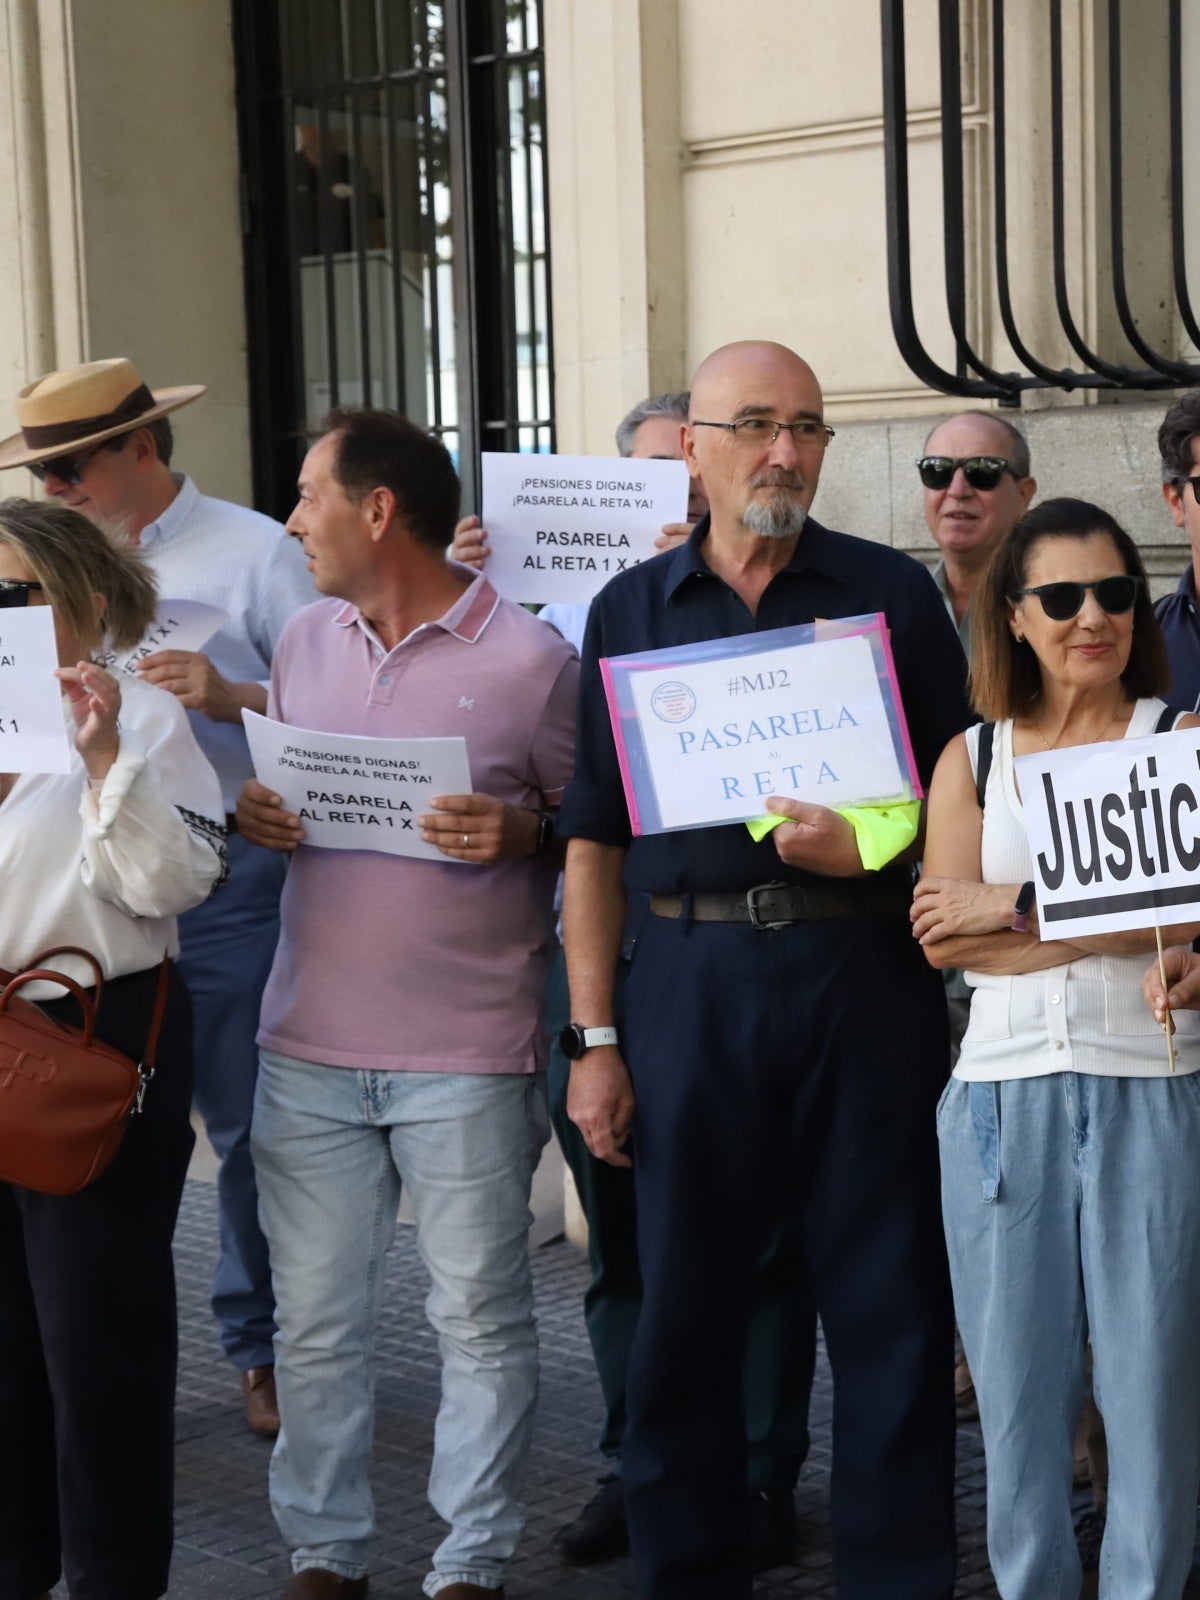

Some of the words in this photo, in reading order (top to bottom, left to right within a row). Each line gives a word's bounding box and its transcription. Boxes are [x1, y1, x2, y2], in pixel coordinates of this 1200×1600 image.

[521, 478, 592, 490] ¡PENSIONES
[596, 481, 646, 492] DIGNAS!
[512, 495, 578, 507] ¡PASARELA
[581, 497, 596, 507] AL
[600, 498, 631, 508] RETA
[634, 499, 653, 509] YA!
[536, 531, 630, 548] PASARELA
[523, 556, 545, 569] AL
[551, 557, 597, 571] RETA
[602, 559, 609, 571] 1
[616, 558, 627, 571] X
[123, 647, 152, 673] ETA
[156, 626, 171, 638] X
[0, 655, 15, 667] A!
[727, 669, 791, 696] #MJ2
[10, 719, 18, 733] 1
[678, 705, 859, 754] PASARELA
[283, 746, 361, 765] ¡PENSIONES
[365, 757, 420, 769] DIGNAS!
[768, 750, 781, 760] AL
[278, 757, 349, 776] ¡PASARELA
[353, 768, 370, 778] AL
[373, 771, 408, 783] RETA
[410, 775, 432, 784] YA!
[720, 760, 840, 799] RETA
[307, 791, 413, 812] PASARELA
[299, 808, 323, 821] AL
[329, 811, 381, 826] RETA
[386, 816, 393, 827] 1
[401, 818, 414, 830] X
